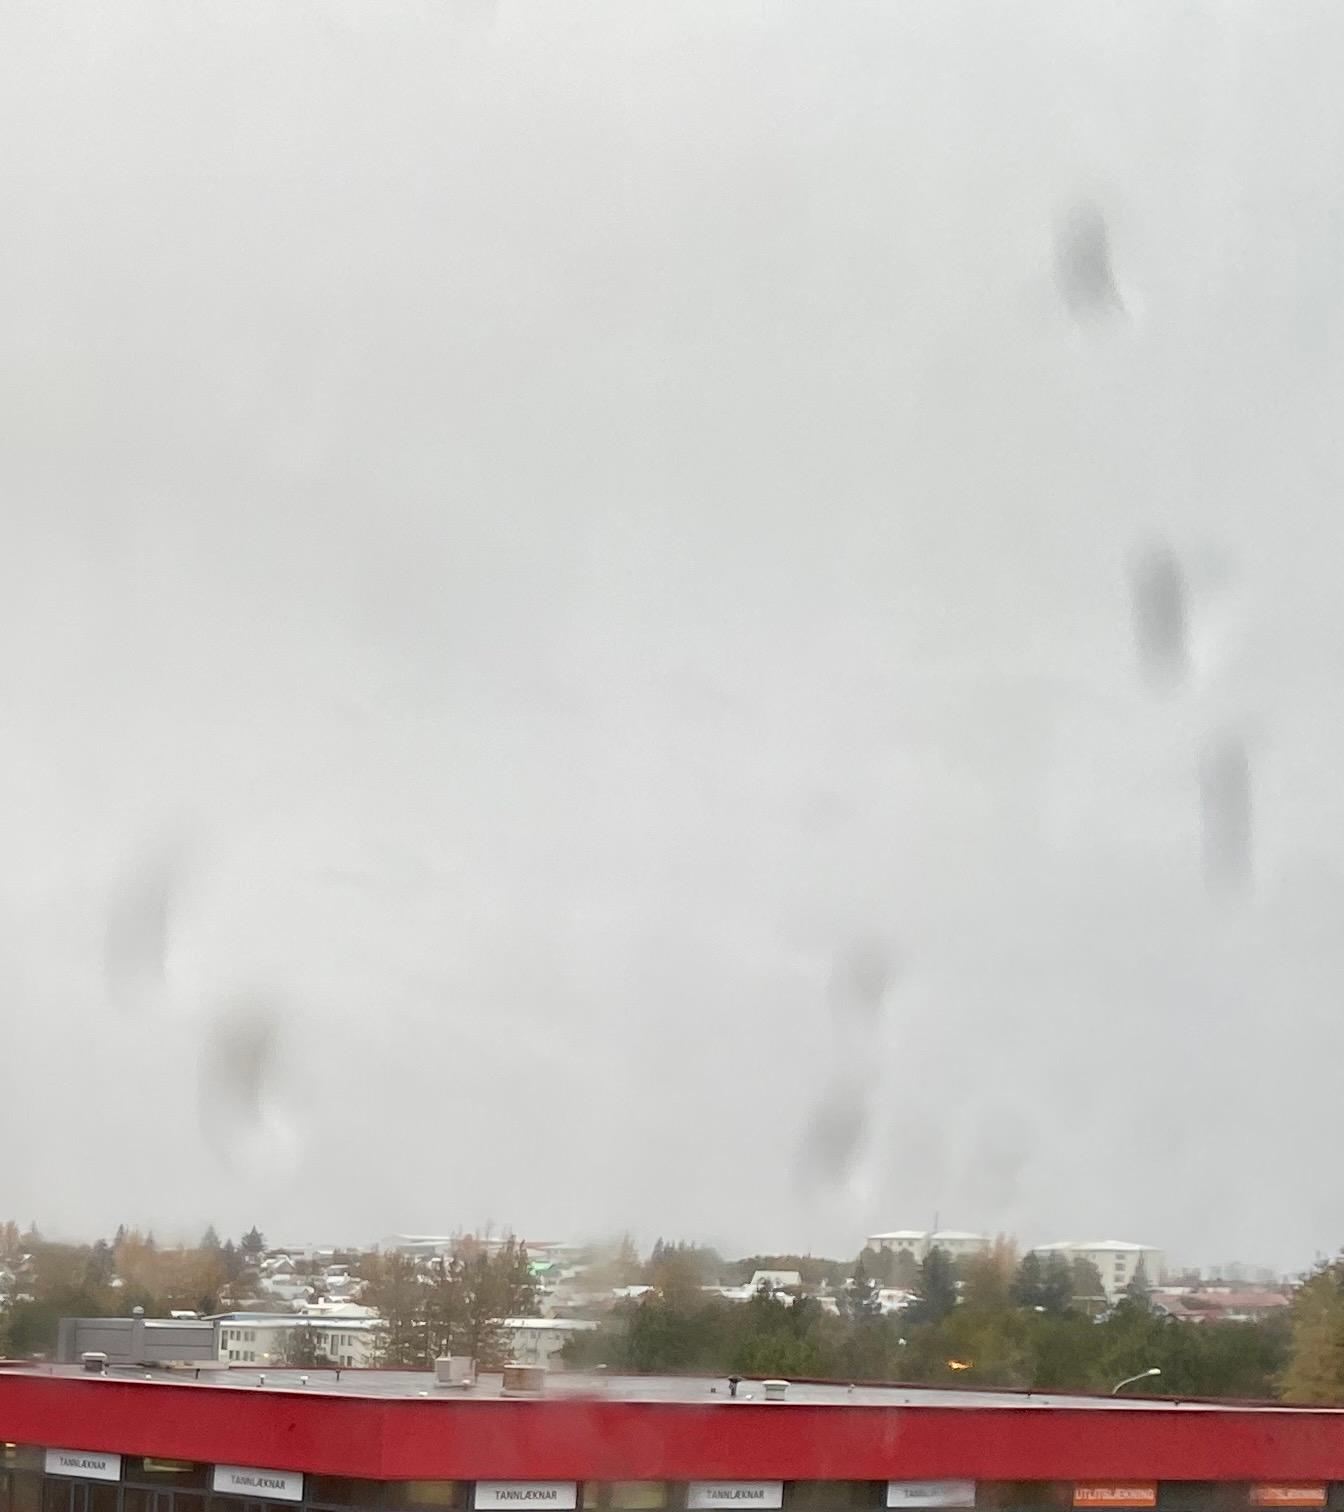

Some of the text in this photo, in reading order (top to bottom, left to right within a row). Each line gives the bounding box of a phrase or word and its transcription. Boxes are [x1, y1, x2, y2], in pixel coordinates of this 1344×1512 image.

[231, 1474, 286, 1490] TANNLÆKNAR
[495, 1489, 557, 1500] TANNLÆKNAR
[706, 1489, 764, 1500] TANNLÆKNAR
